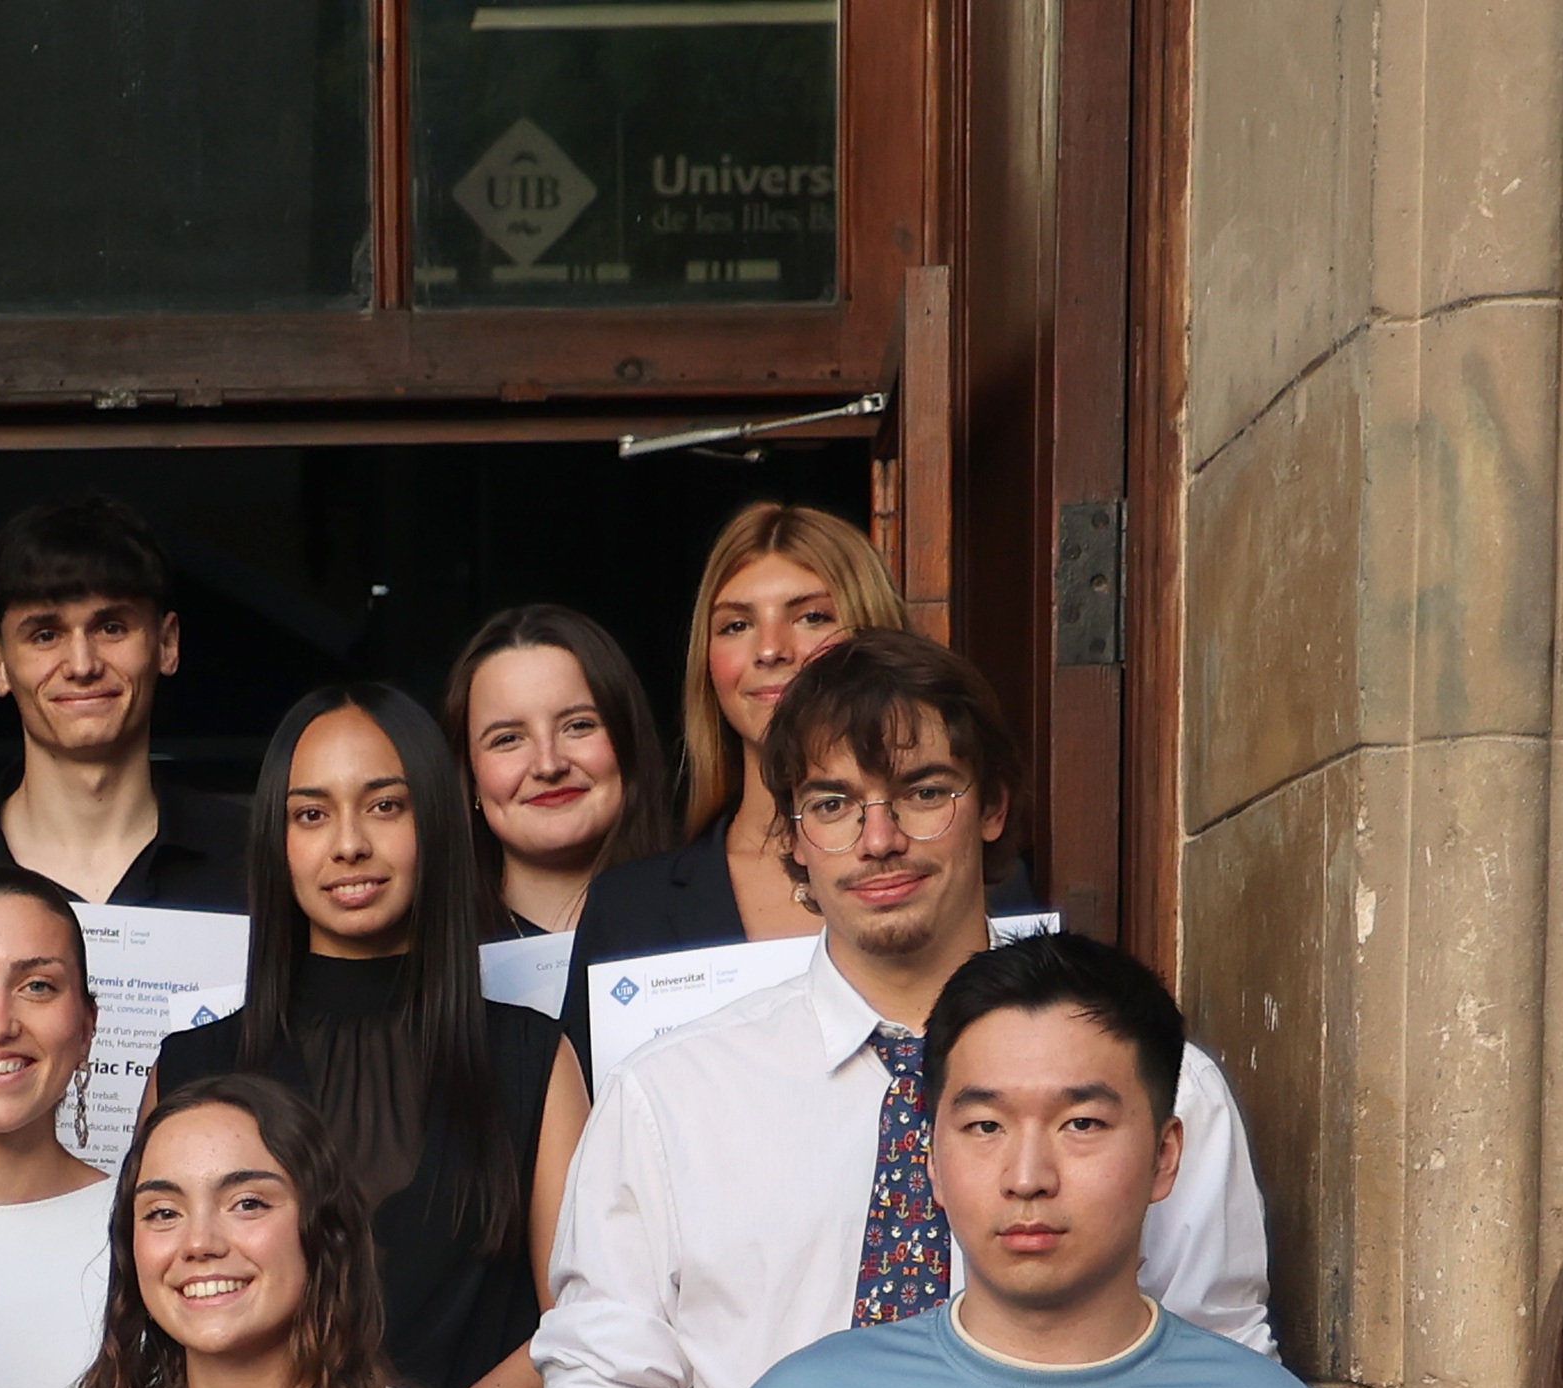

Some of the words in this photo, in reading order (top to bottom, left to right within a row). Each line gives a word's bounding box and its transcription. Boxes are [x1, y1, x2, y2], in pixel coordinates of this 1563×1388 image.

[486, 176, 560, 209] UIB
[88, 975, 124, 988] Premis
[651, 973, 705, 989] Universitat
